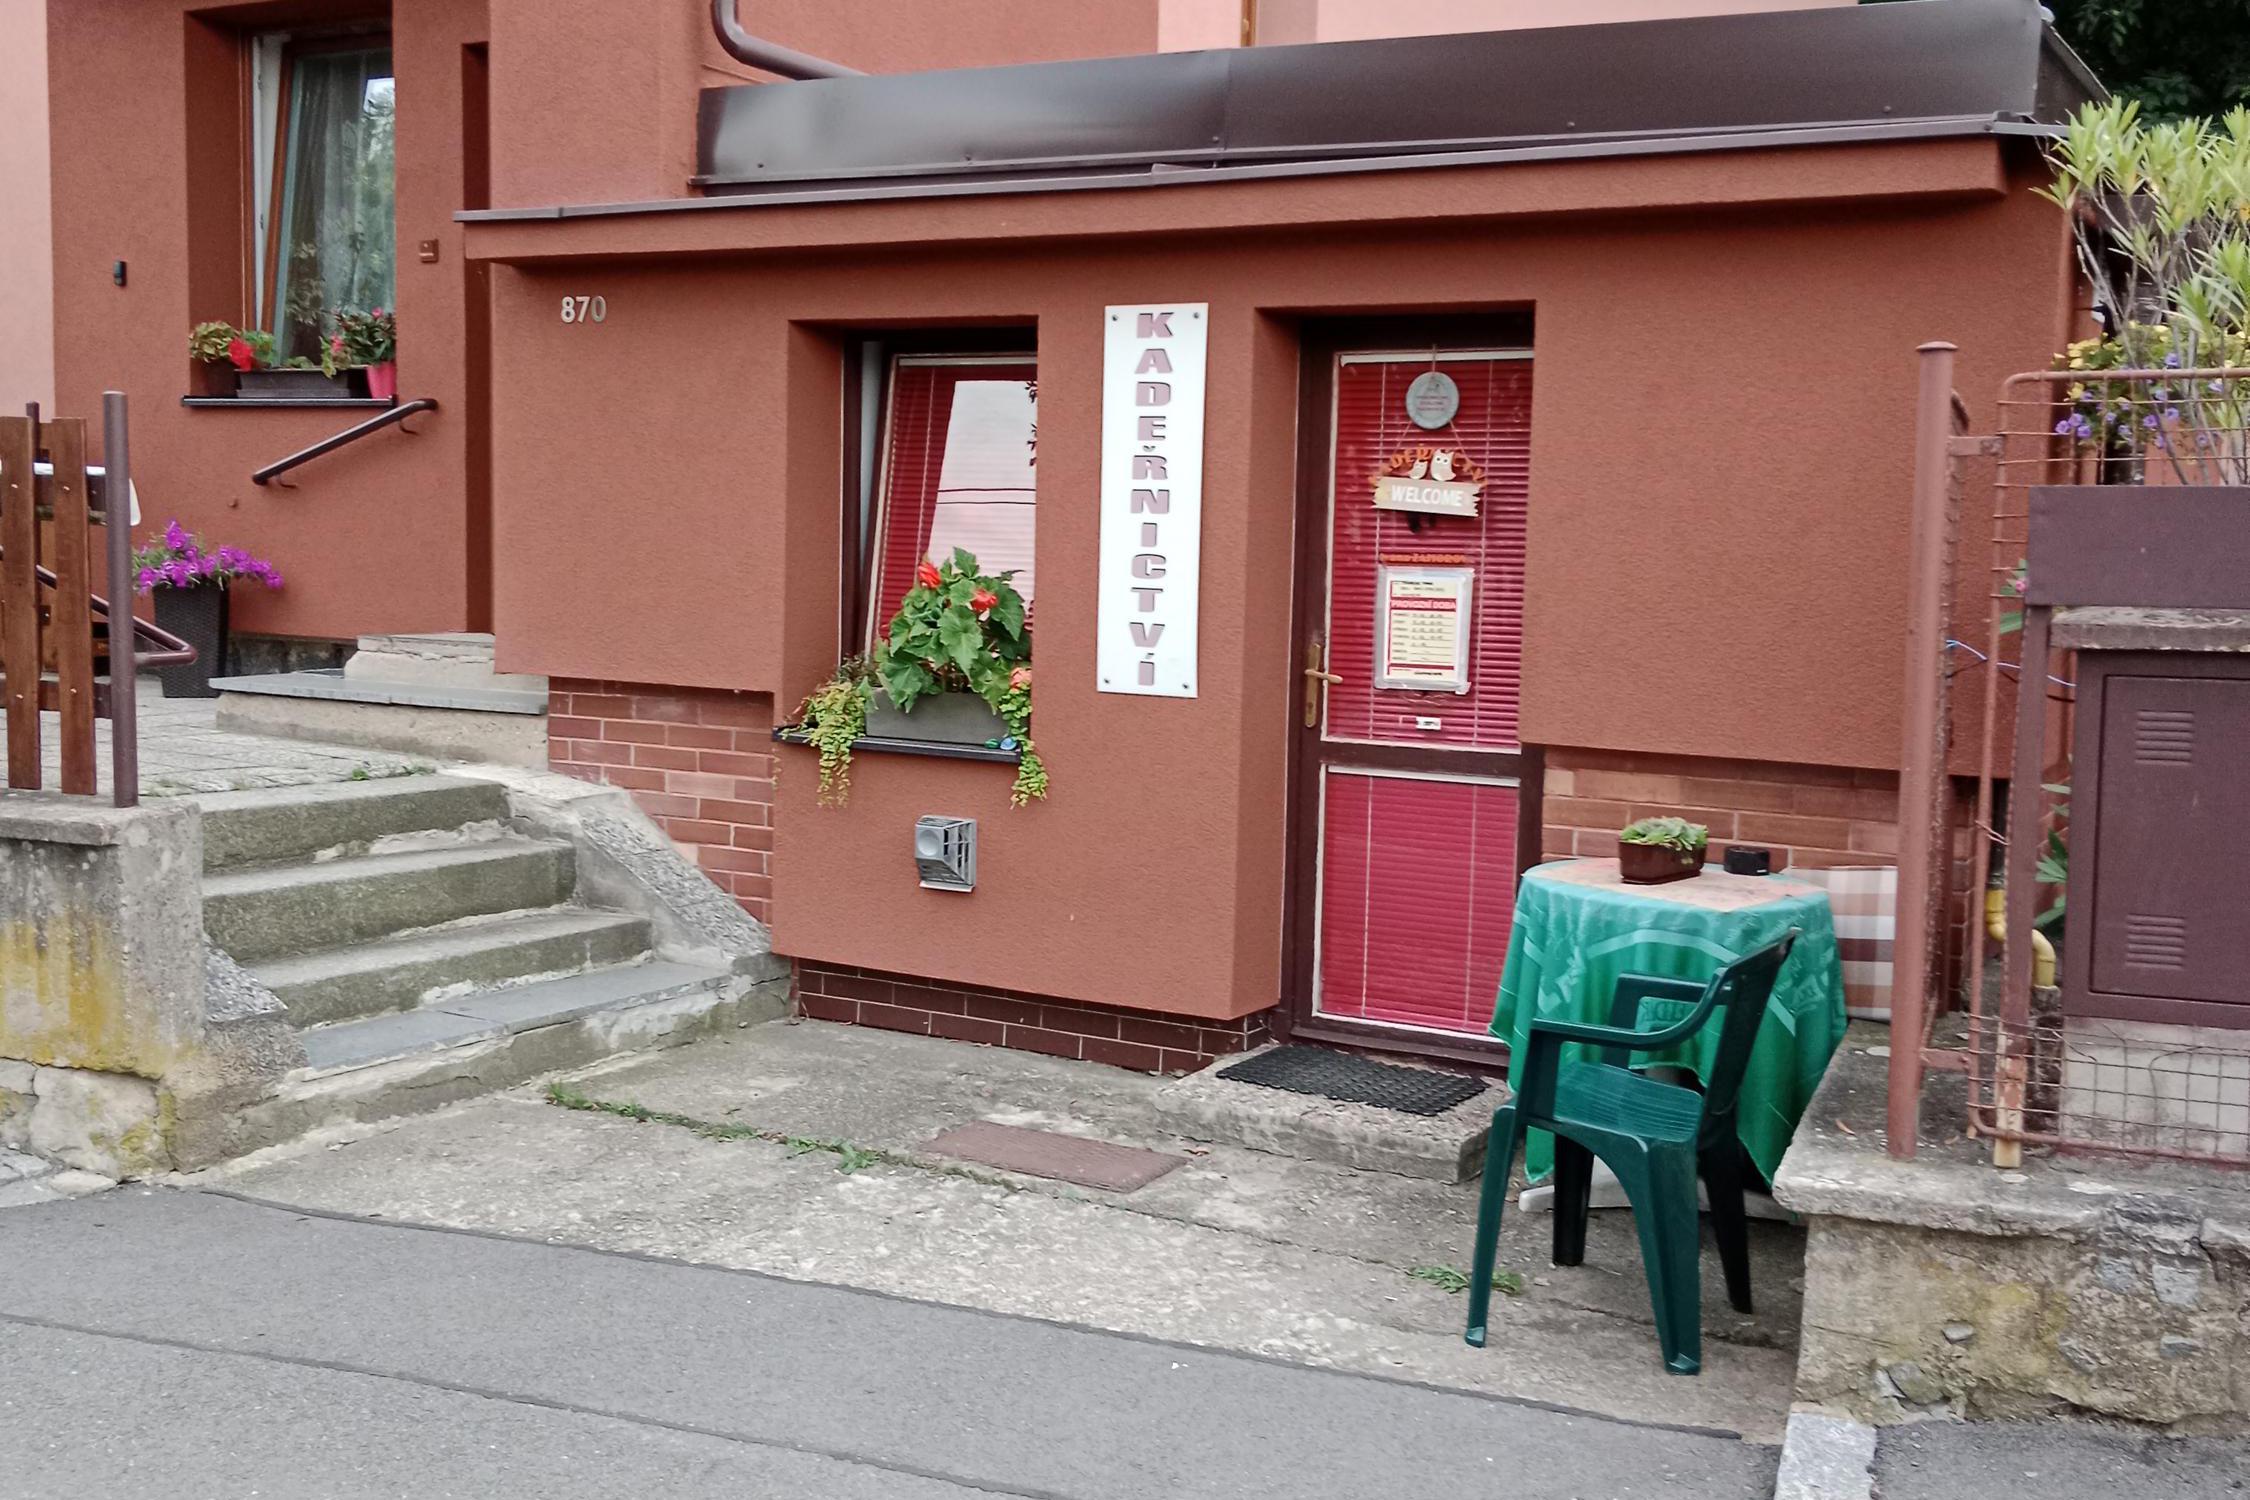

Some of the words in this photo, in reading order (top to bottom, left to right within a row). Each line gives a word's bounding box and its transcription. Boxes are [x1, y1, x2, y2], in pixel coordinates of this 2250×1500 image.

[561, 295, 607, 323] 870
[1128, 312, 1174, 687] KADEŘNICTVÍ
[1391, 484, 1464, 507] WELCOME
